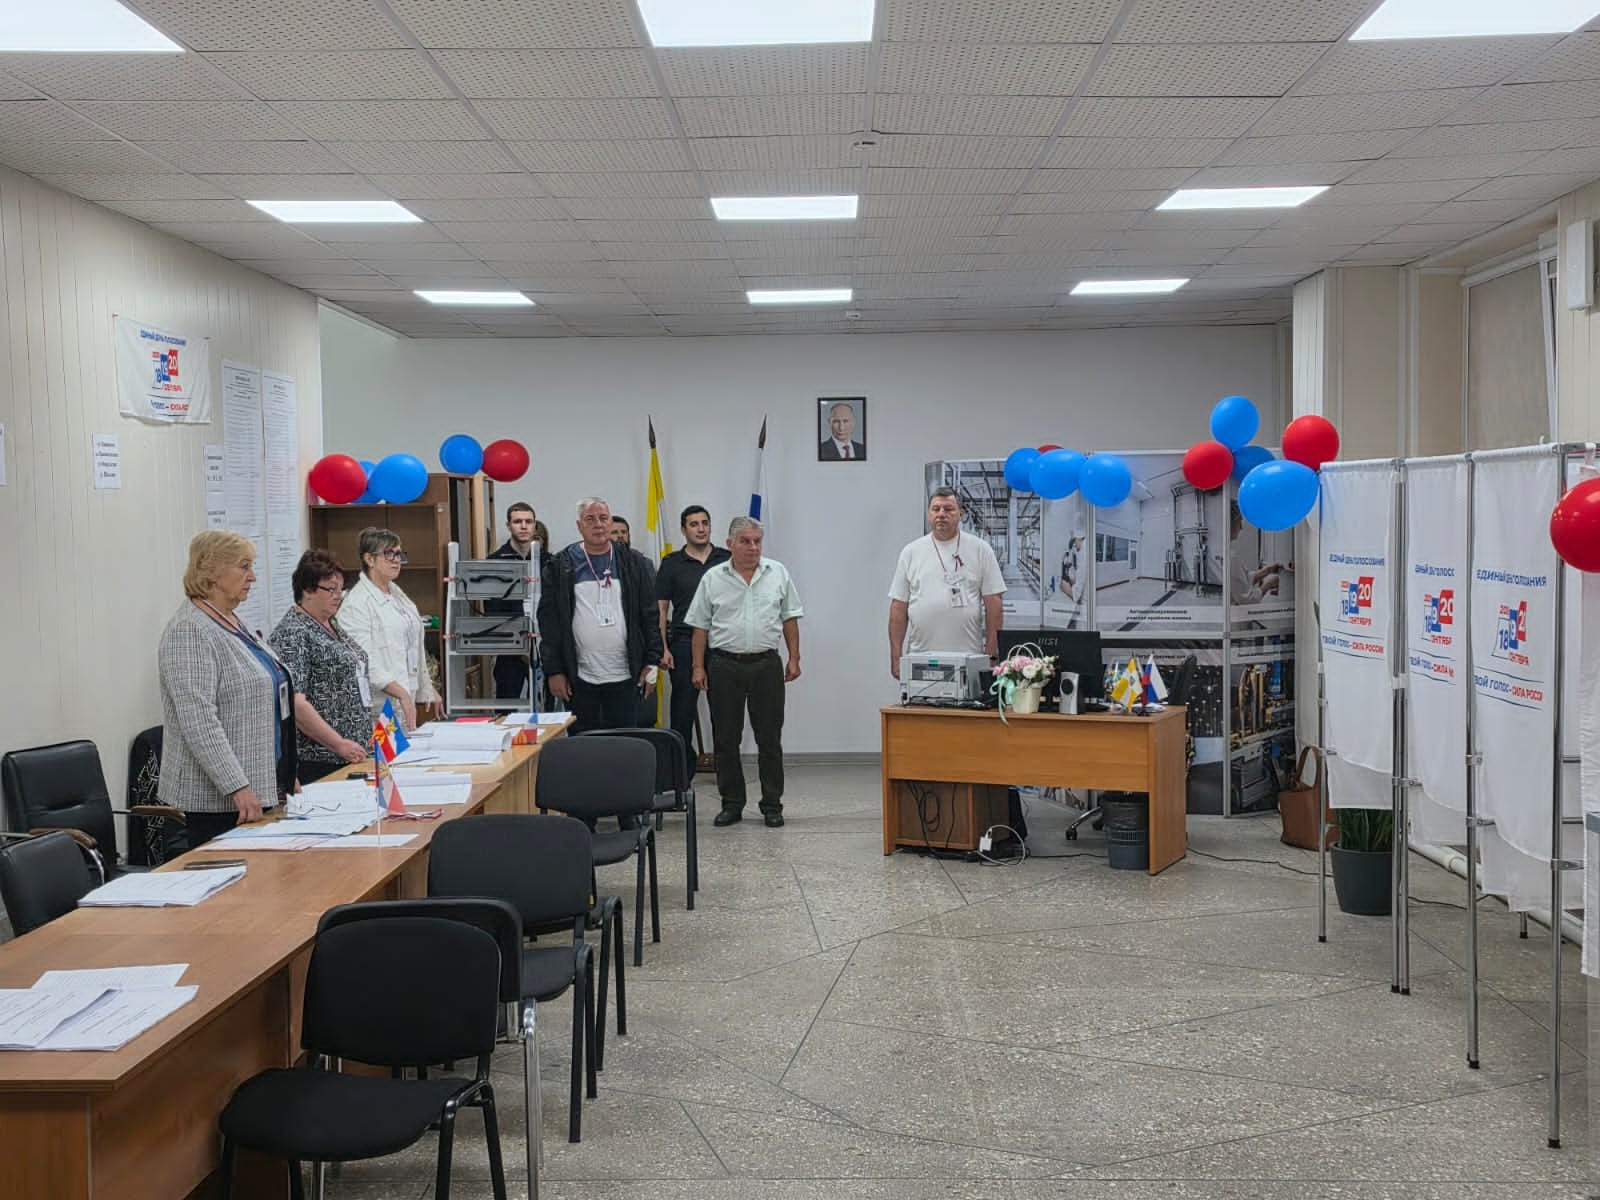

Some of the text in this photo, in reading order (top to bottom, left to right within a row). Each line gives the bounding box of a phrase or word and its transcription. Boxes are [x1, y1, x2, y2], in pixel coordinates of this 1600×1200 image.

[168, 356, 177, 370] 20
[1358, 583, 1371, 601] 20
[1440, 598, 1453, 617] 20
[1499, 629, 1509, 651] 18
